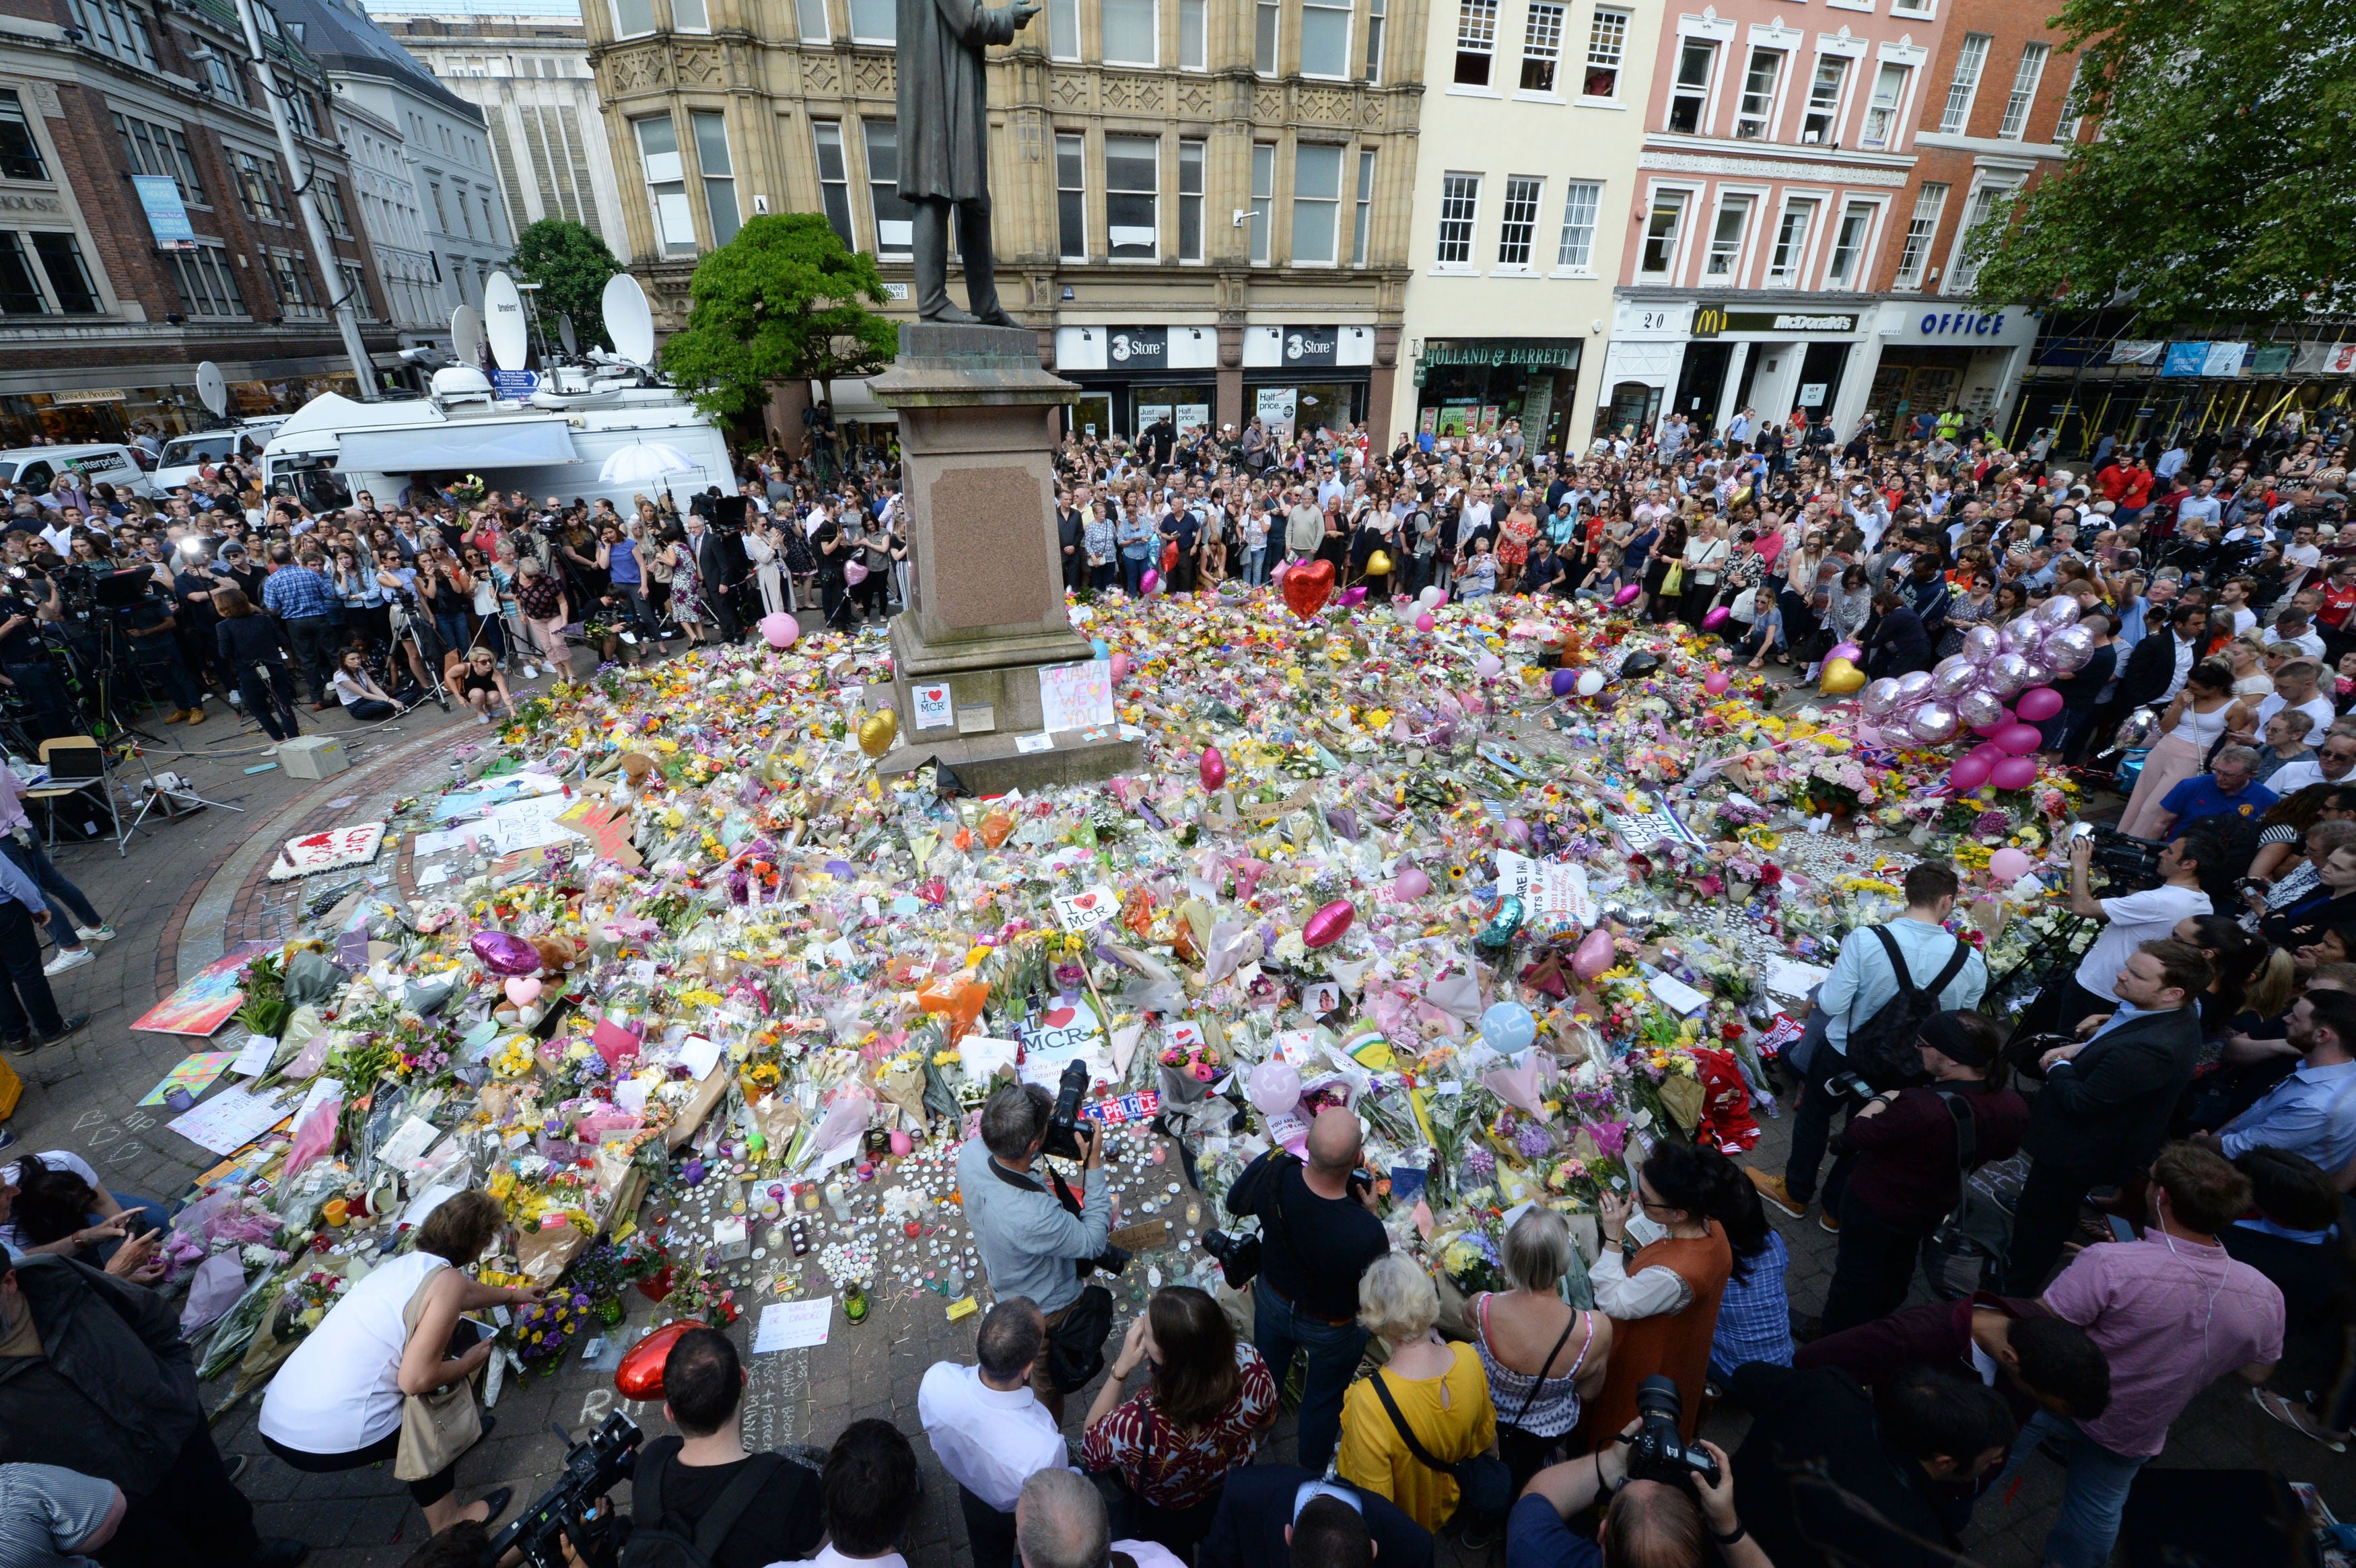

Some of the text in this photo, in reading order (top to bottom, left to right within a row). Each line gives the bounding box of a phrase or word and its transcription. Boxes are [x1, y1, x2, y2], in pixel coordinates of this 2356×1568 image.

[1773, 314, 1852, 330] McDonald's
[1920, 313, 2005, 335] OFFICE
[1132, 341, 1160, 355] Store
[1304, 340, 1330, 354] Store
[1426, 348, 1570, 367] HOLLAND & BARRETT
[1259, 392, 1276, 401] Half
[1443, 414, 1465, 423] better
[71, 456, 124, 470] enterprise
[1041, 660, 1105, 686] ARIANA
[921, 692, 928, 703] I
[1056, 682, 1087, 708] WE
[921, 701, 946, 713] MCR
[1063, 707, 1099, 727] YOU
[1253, 808, 1267, 816] Rest
[1061, 900, 1078, 915] I
[1067, 905, 1110, 929] MCR
[1023, 1013, 1041, 1035] I
[1021, 1027, 1088, 1054] MCR
[1032, 1063, 1049, 1071] City
[1091, 1092, 1144, 1108] SUPER EAGLES
[1103, 1094, 1159, 1120] PALACE
[124, 1111, 156, 1131] RIP
[1271, 1120, 1282, 1129] YOU
[788, 1302, 807, 1312] WILL
[812, 1300, 830, 1310] NOT
[769, 1310, 825, 1325] BE DIVIDED
